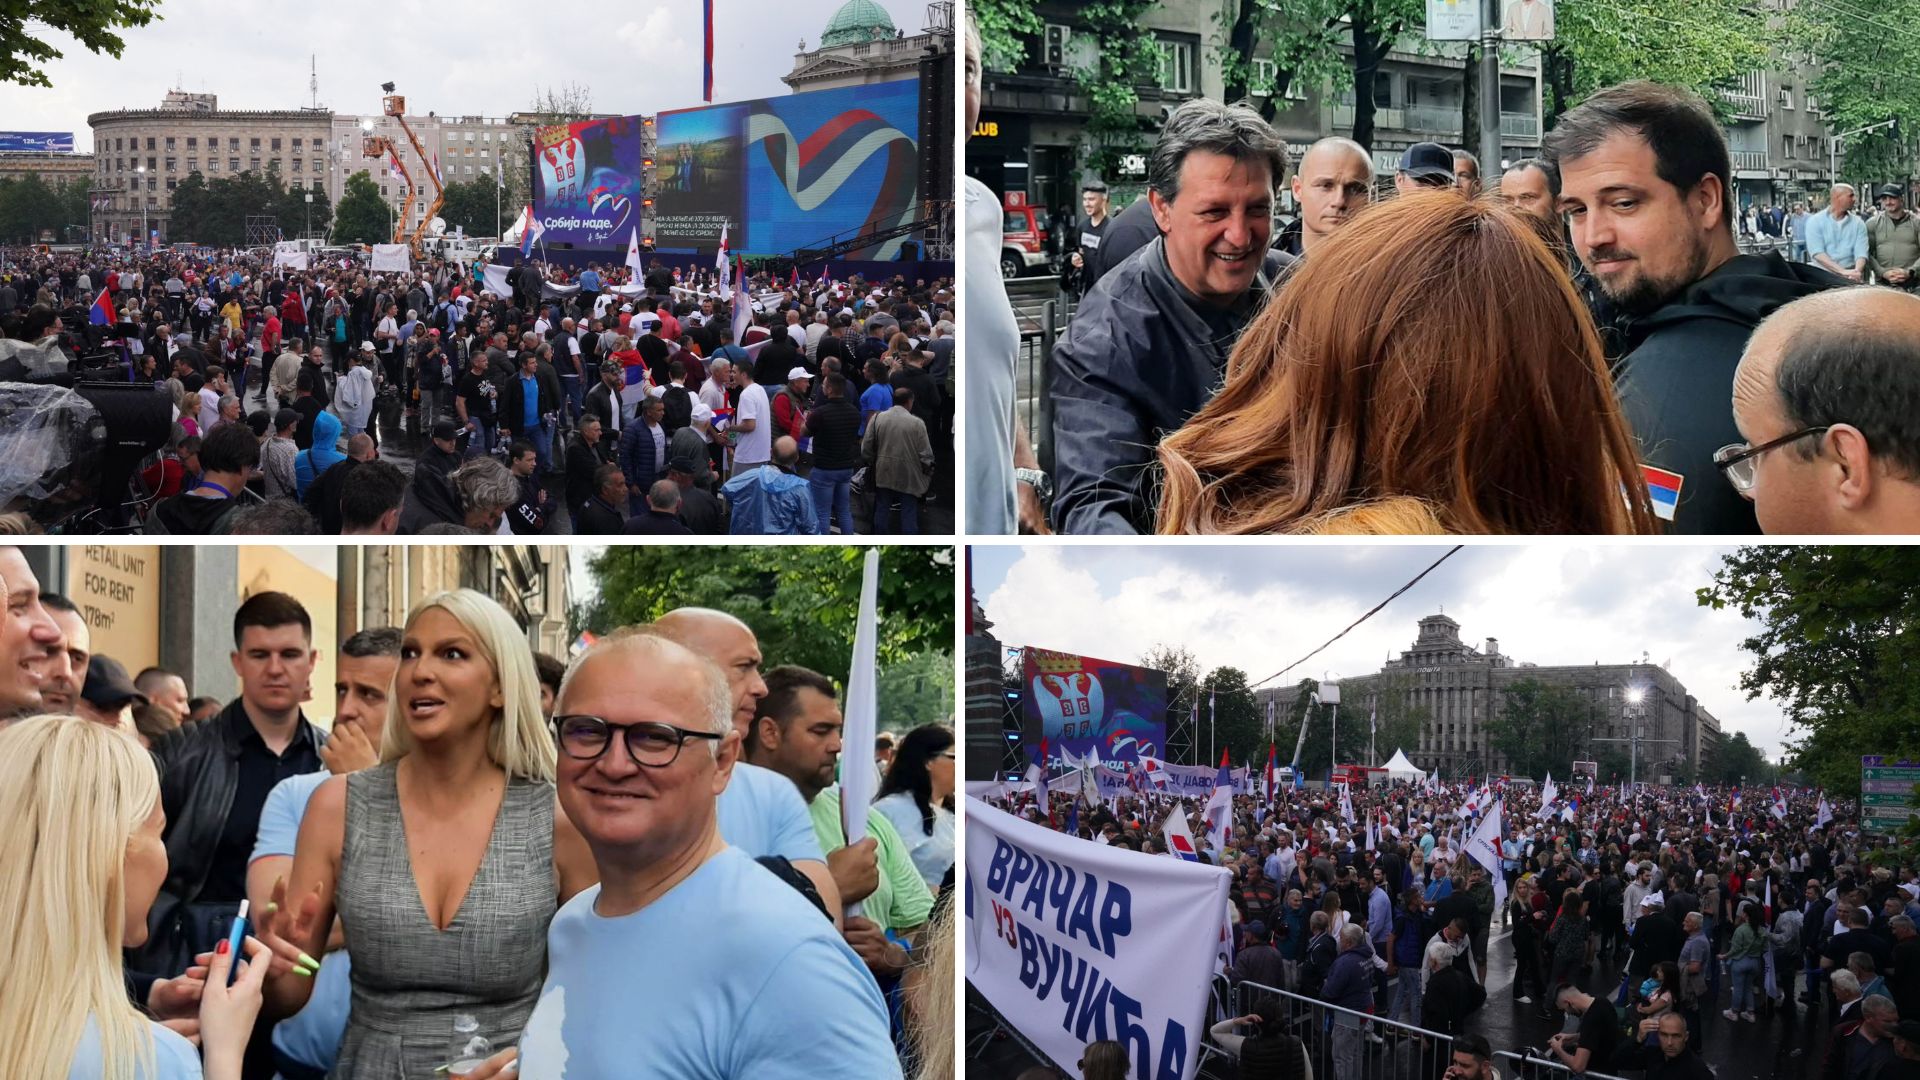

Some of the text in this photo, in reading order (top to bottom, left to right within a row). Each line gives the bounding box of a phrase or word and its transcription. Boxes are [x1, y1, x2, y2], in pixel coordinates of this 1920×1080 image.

[544, 216, 613, 231] Србија наде.
[518, 503, 537, 525] 5.11
[85, 545, 145, 577] RETAIL UNIT
[85, 572, 135, 605] FOR RENT
[987, 835, 1132, 959] ВРАЧАР
[992, 899, 1018, 950] УЗ
